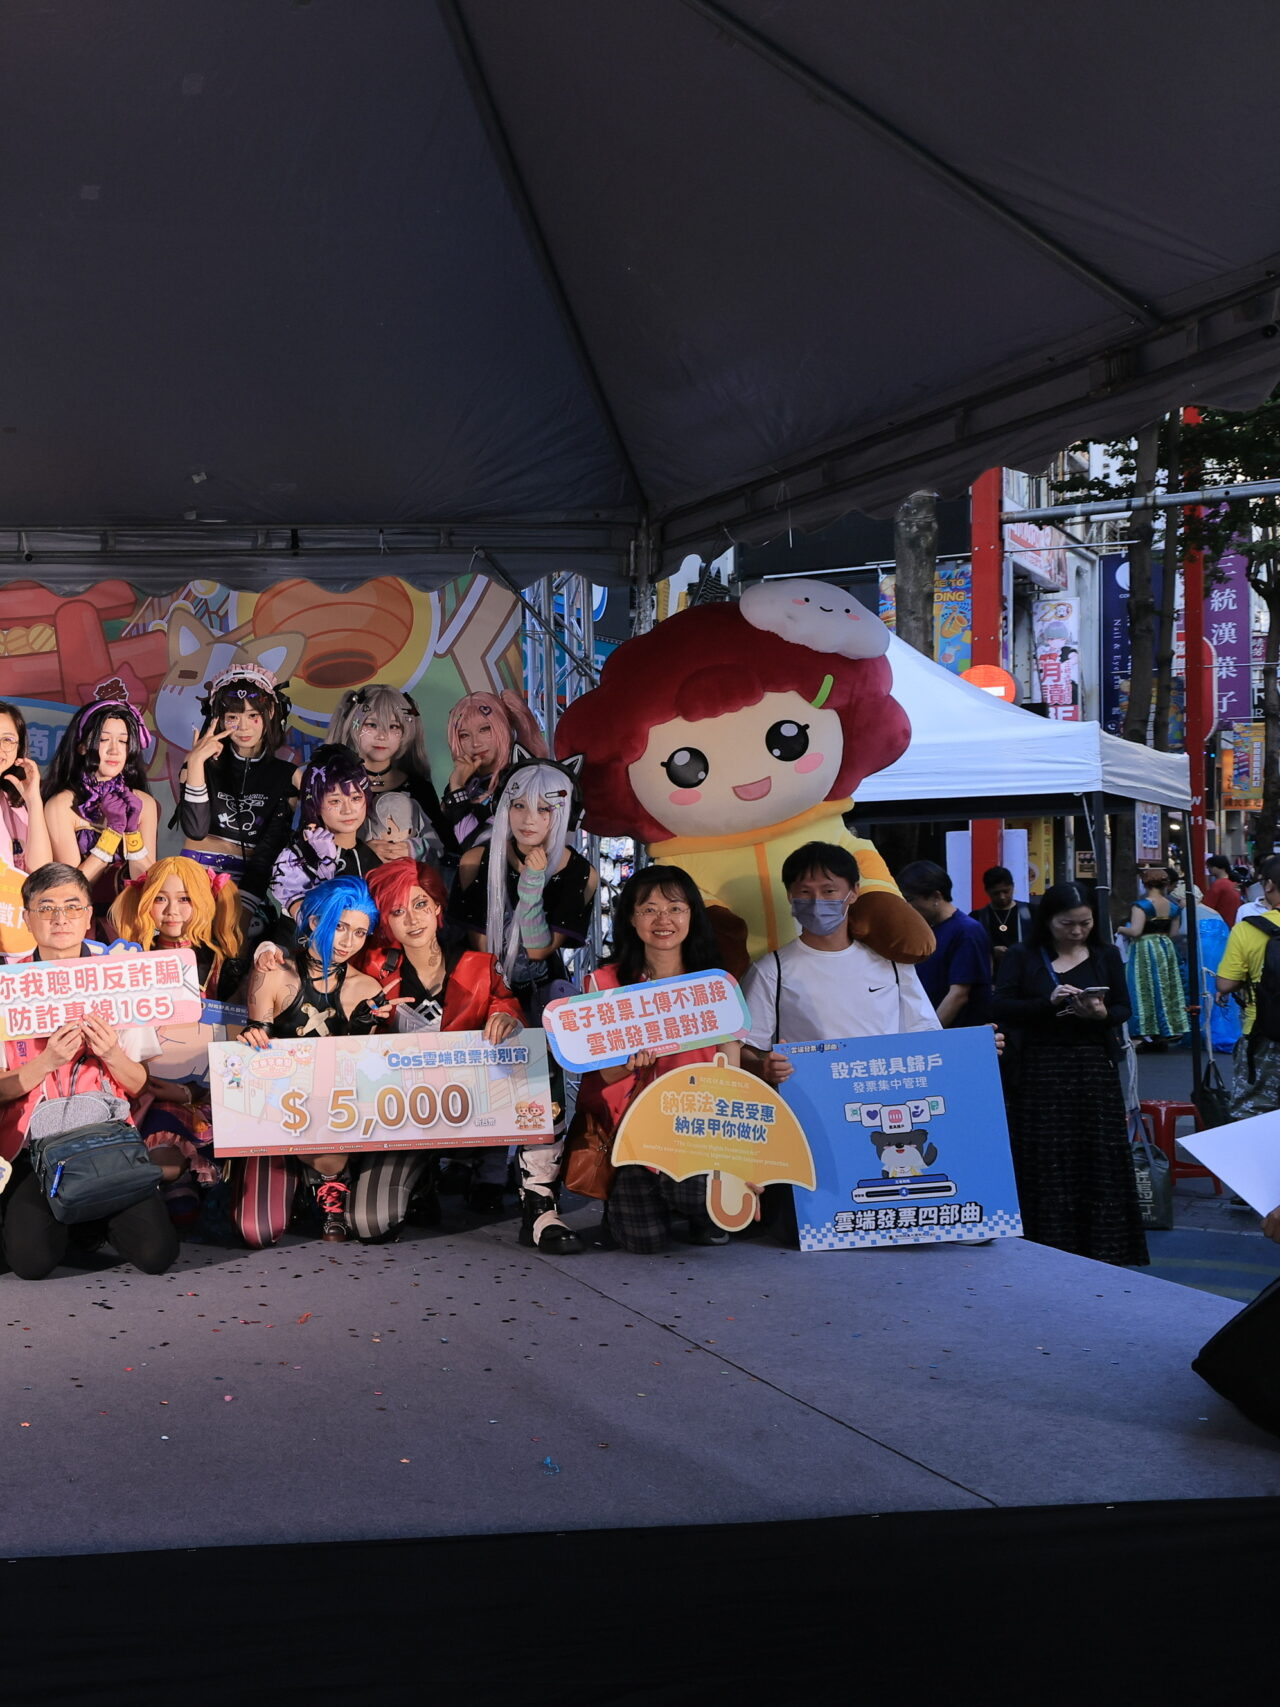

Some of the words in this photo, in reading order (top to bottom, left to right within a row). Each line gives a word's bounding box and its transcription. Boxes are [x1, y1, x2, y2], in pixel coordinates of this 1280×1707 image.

[949, 578, 966, 587] TO
[8, 995, 172, 1034] 防詐專線165
[558, 980, 728, 1033] 電子發票上傳不漏接
[586, 1010, 719, 1056] 雲端發票最對接
[387, 1046, 529, 1068] Cos雲端發票特別賞
[830, 1054, 944, 1079] 設定載具歸戶
[852, 1076, 929, 1094] 發票集中管理
[329, 1084, 470, 1137] 5,000
[674, 1115, 768, 1142] 納保甲你做伙
[834, 1203, 982, 1232] 雲端發票四部曲
